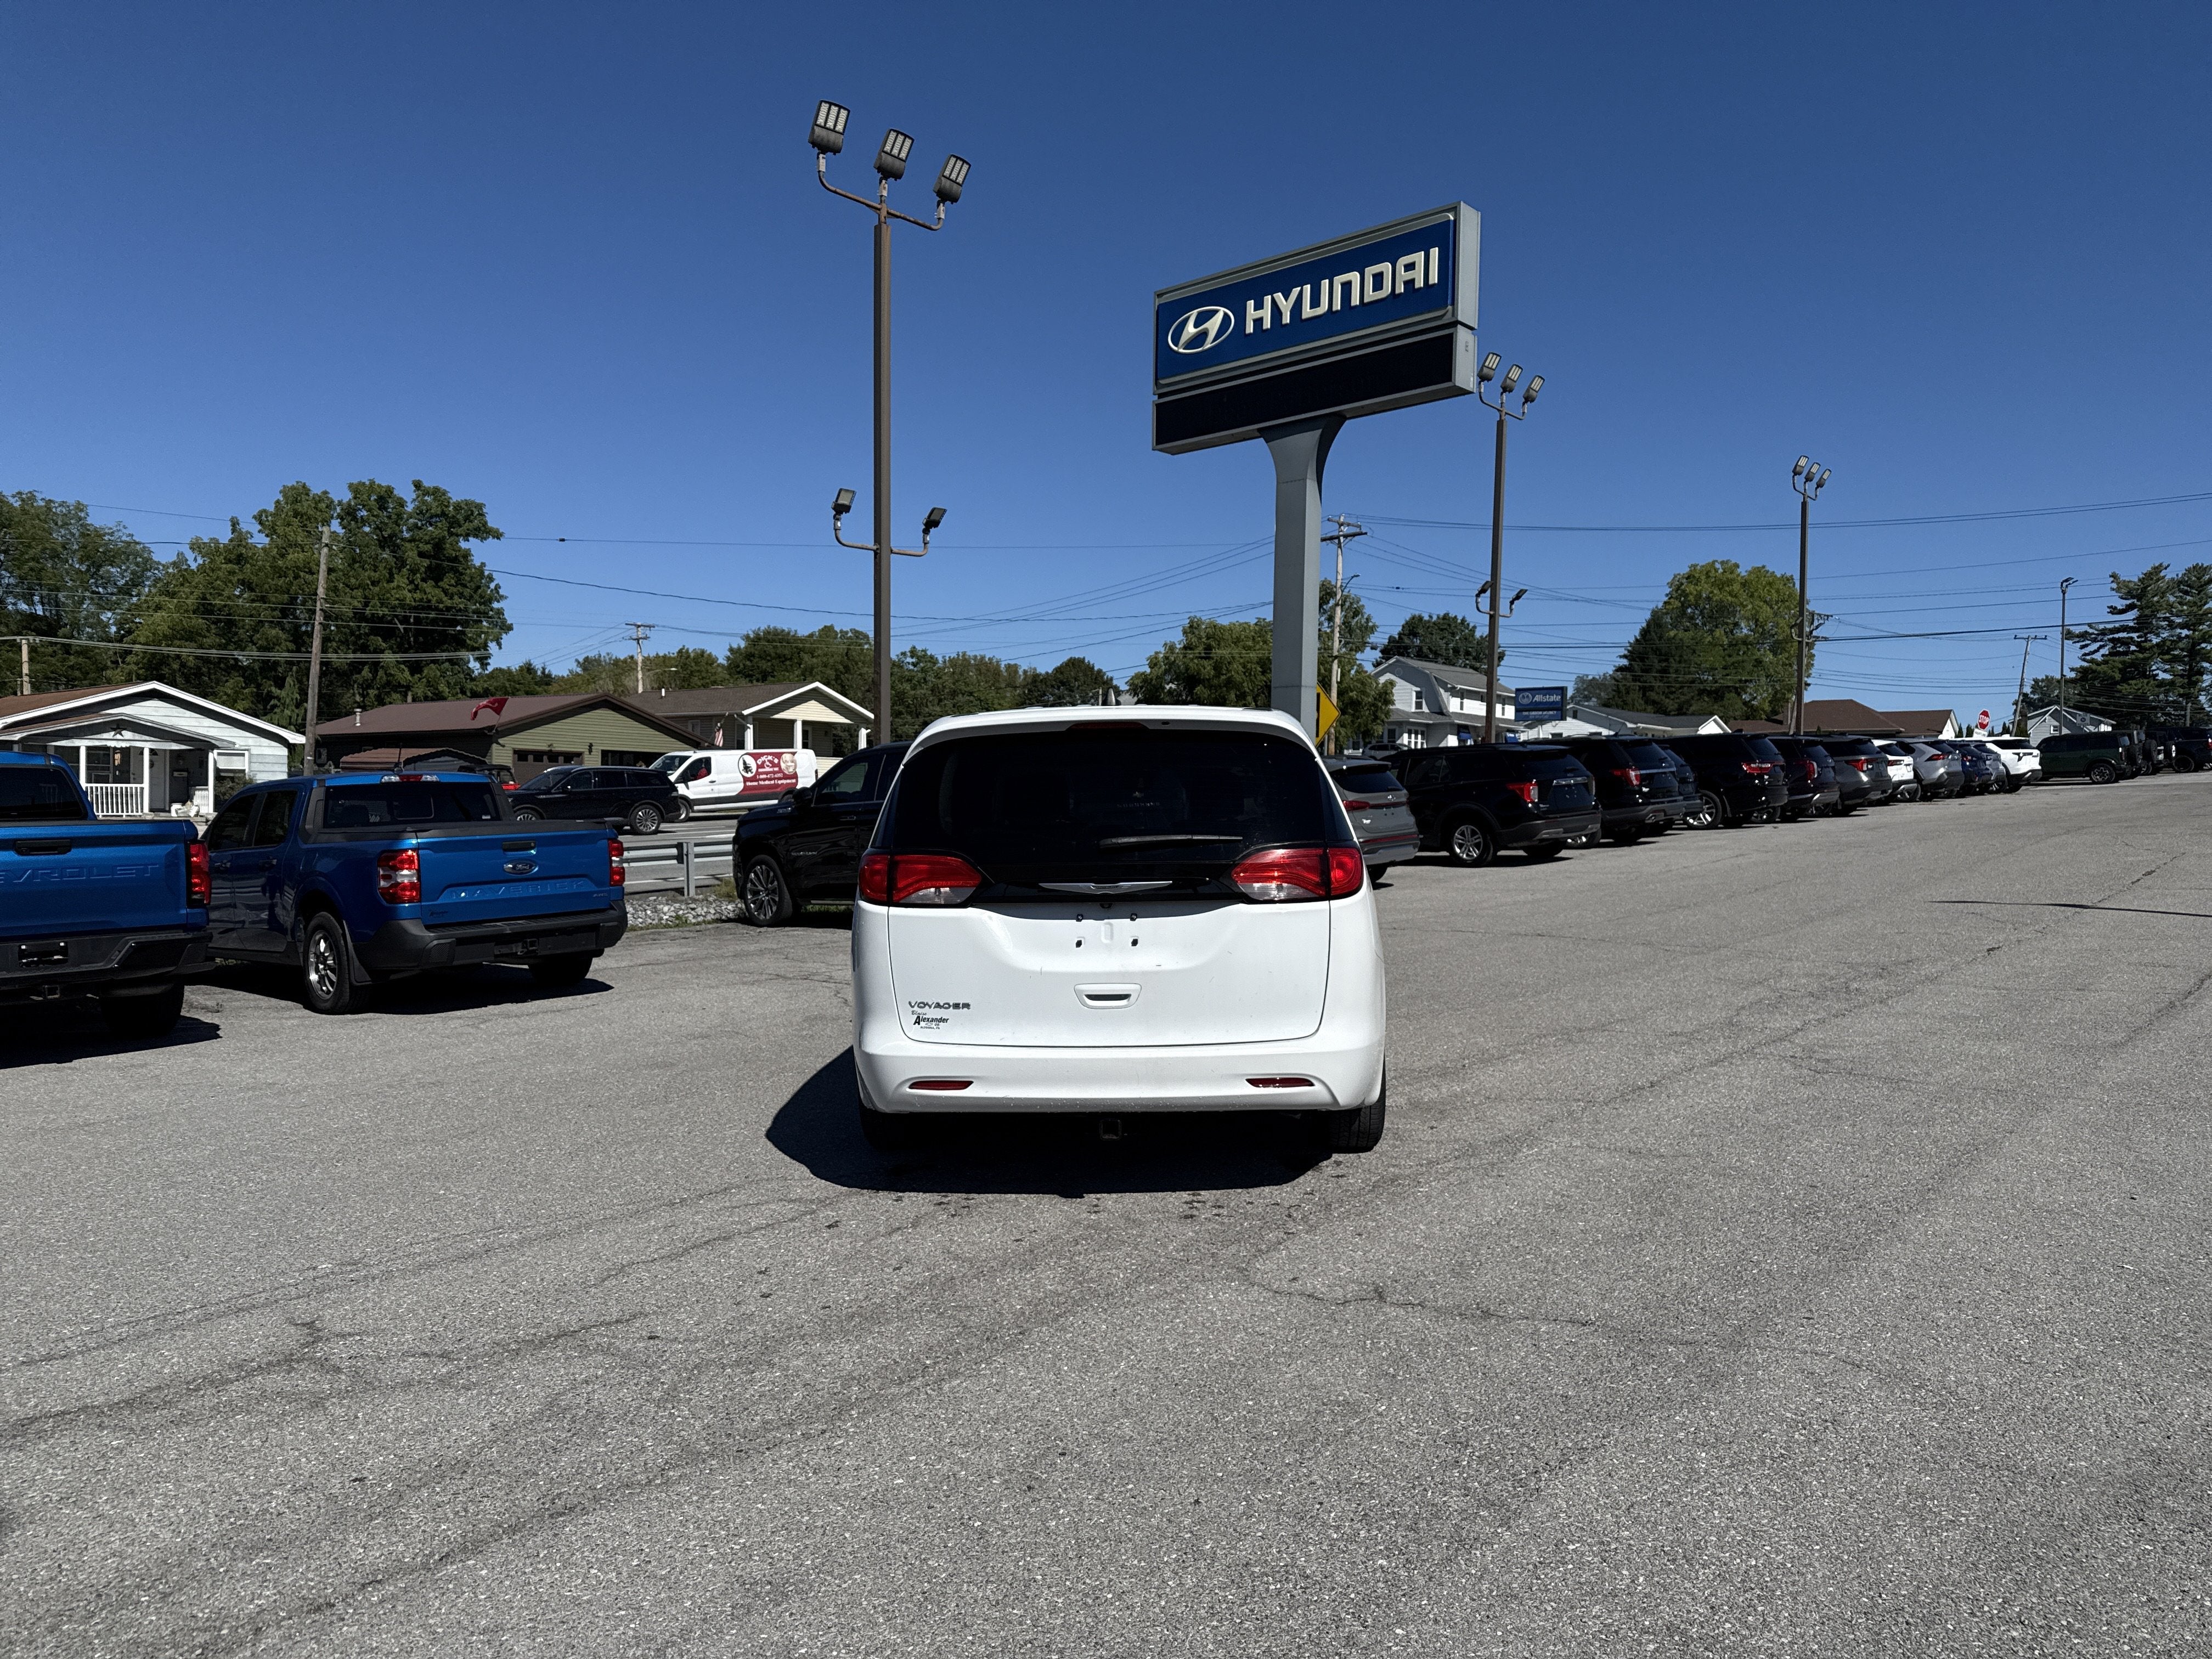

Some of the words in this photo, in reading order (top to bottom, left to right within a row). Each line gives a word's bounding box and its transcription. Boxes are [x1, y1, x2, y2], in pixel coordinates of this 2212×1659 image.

[1245, 247, 1439, 335] HYUNDAI
[1532, 693, 1561, 702] Allstate
[1978, 714, 1989, 725] STOP
[756, 755, 779, 765] DICK'S
[451, 881, 584, 900] MAVERICK
[909, 1001, 971, 1010] VOYAGER
[913, 1015, 950, 1025] Alexander
